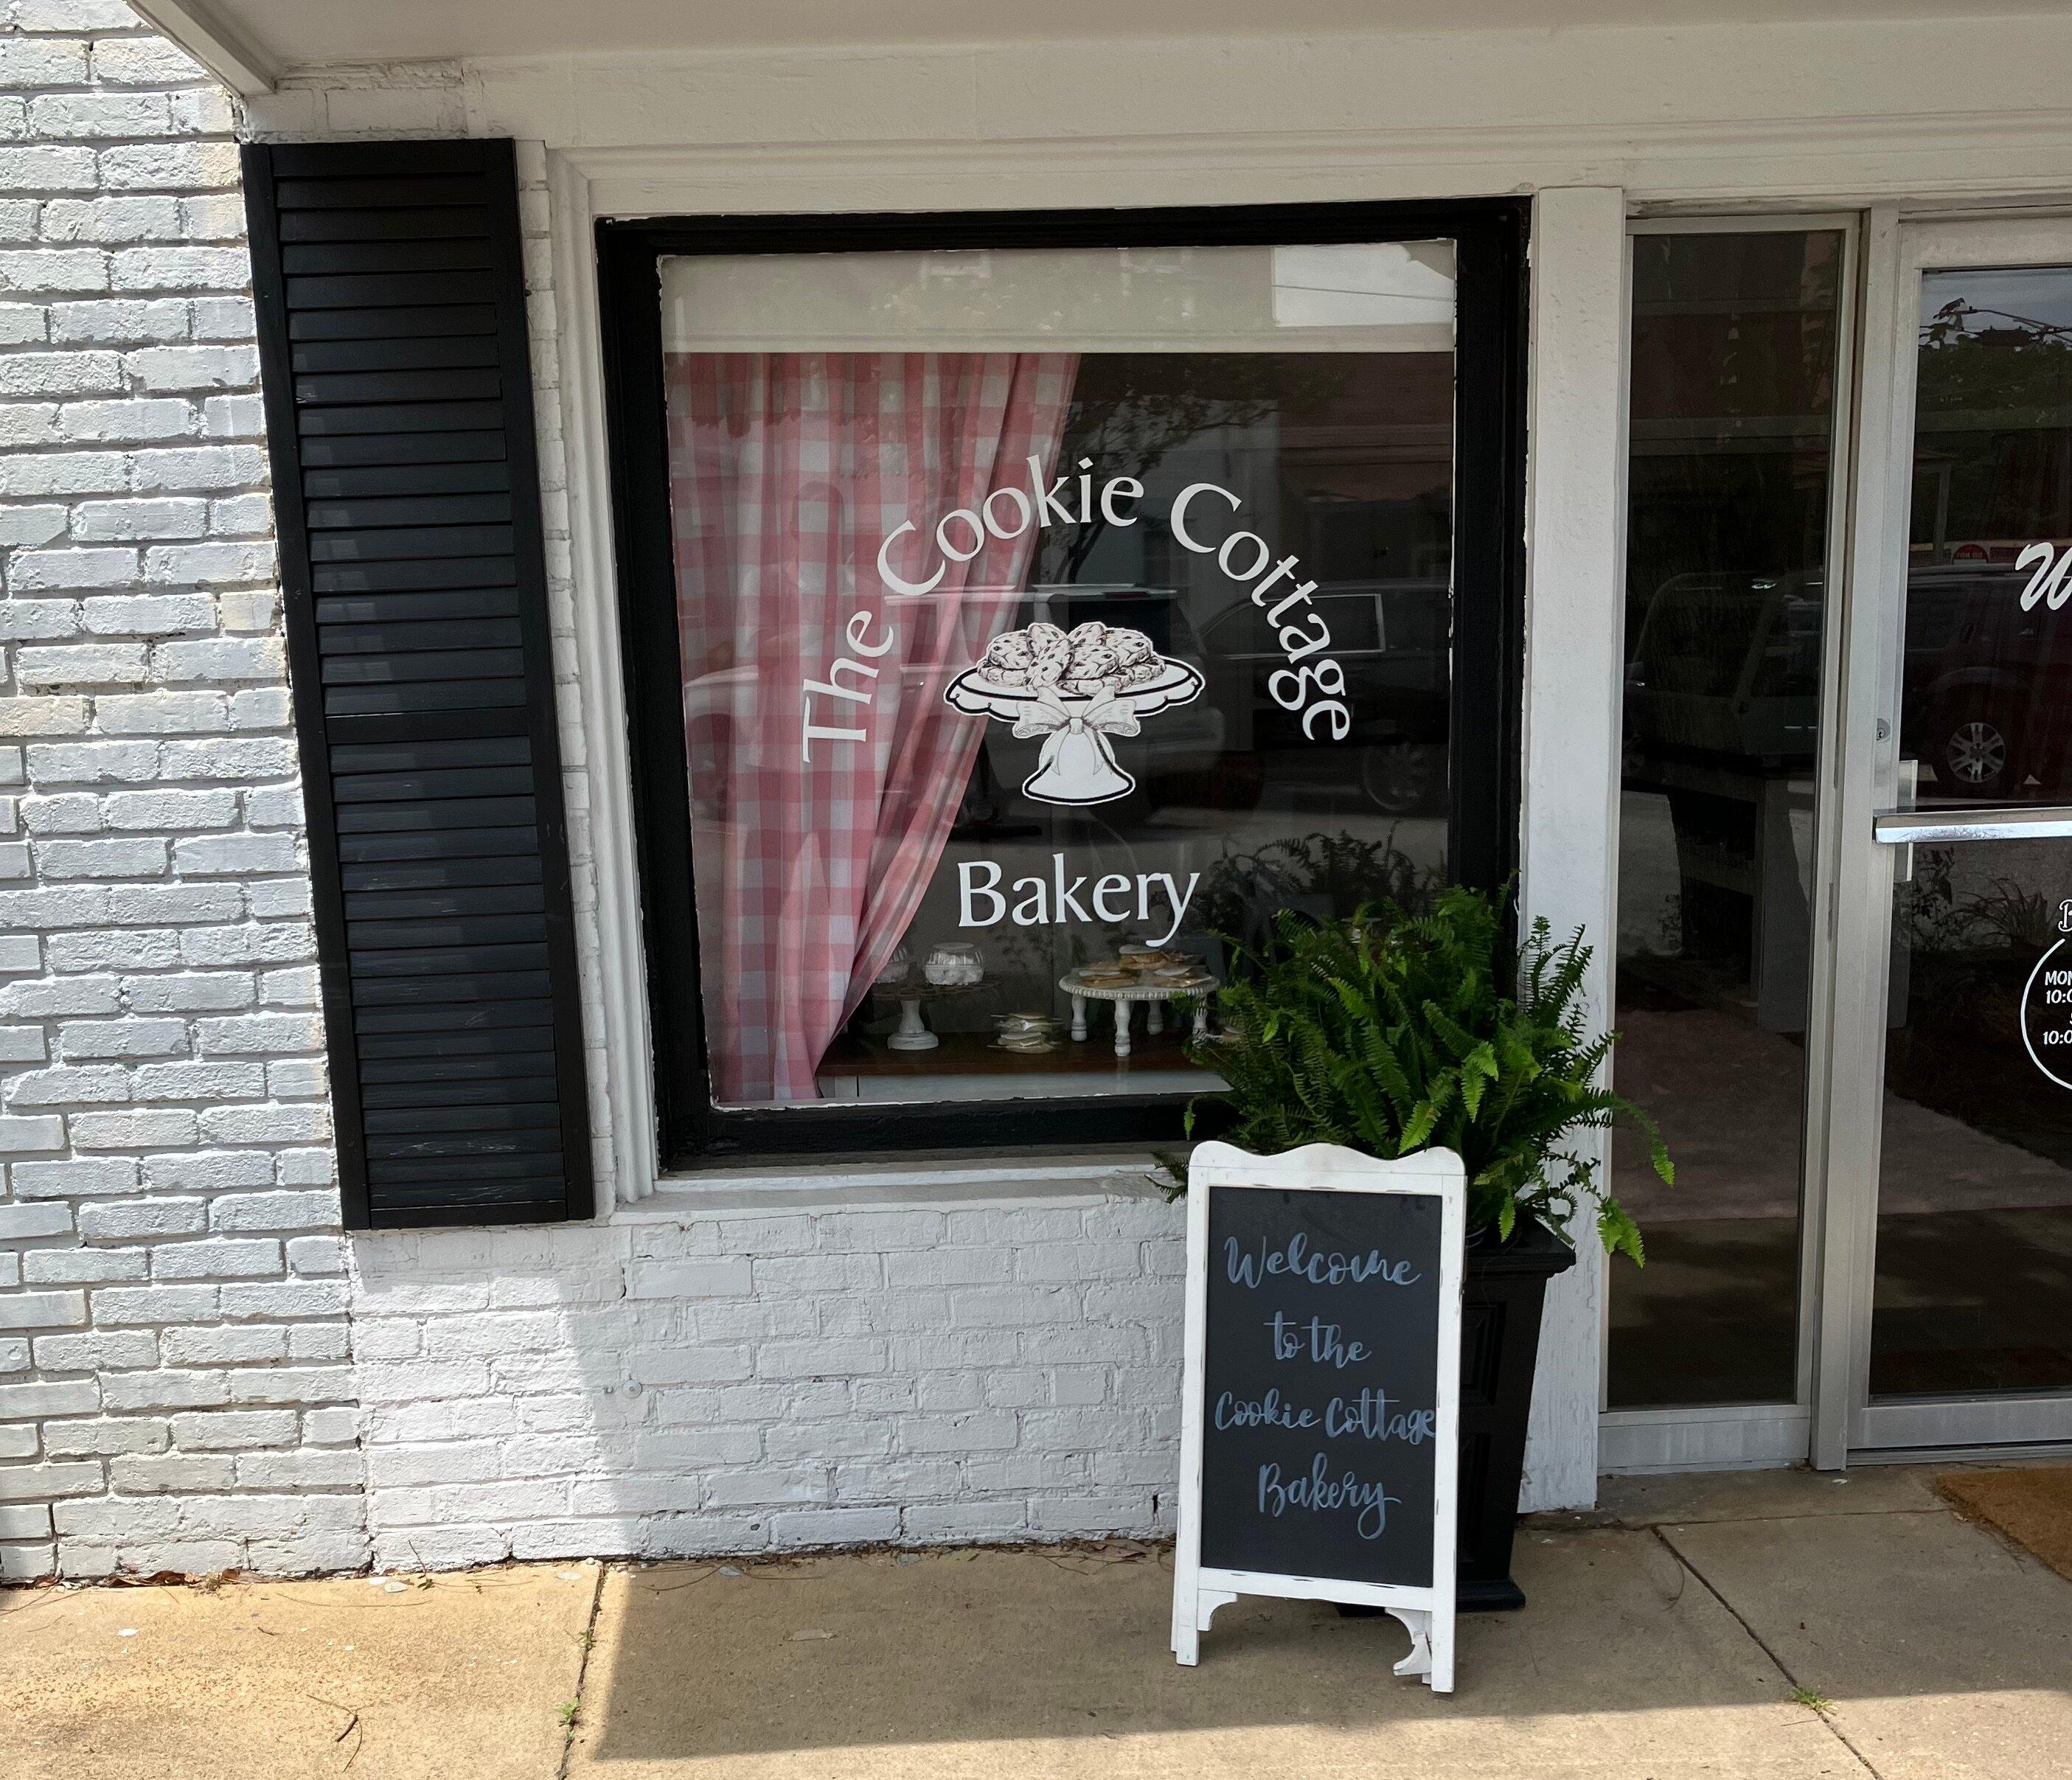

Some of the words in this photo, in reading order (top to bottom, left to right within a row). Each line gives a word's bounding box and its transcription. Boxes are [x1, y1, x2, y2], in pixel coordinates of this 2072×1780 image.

[802, 610, 894, 764] The
[876, 453, 1144, 597] Cookie
[1169, 482, 1351, 742] Cottage
[956, 852, 1200, 948] Bakery
[1224, 1232, 1422, 1289] Welcome
[1263, 1310, 1304, 1360] to
[1301, 1315, 1372, 1369] the
[1214, 1388, 1321, 1431] Cookie
[1325, 1386, 1436, 1446] Cottage
[1257, 1451, 1402, 1540] Bakery
